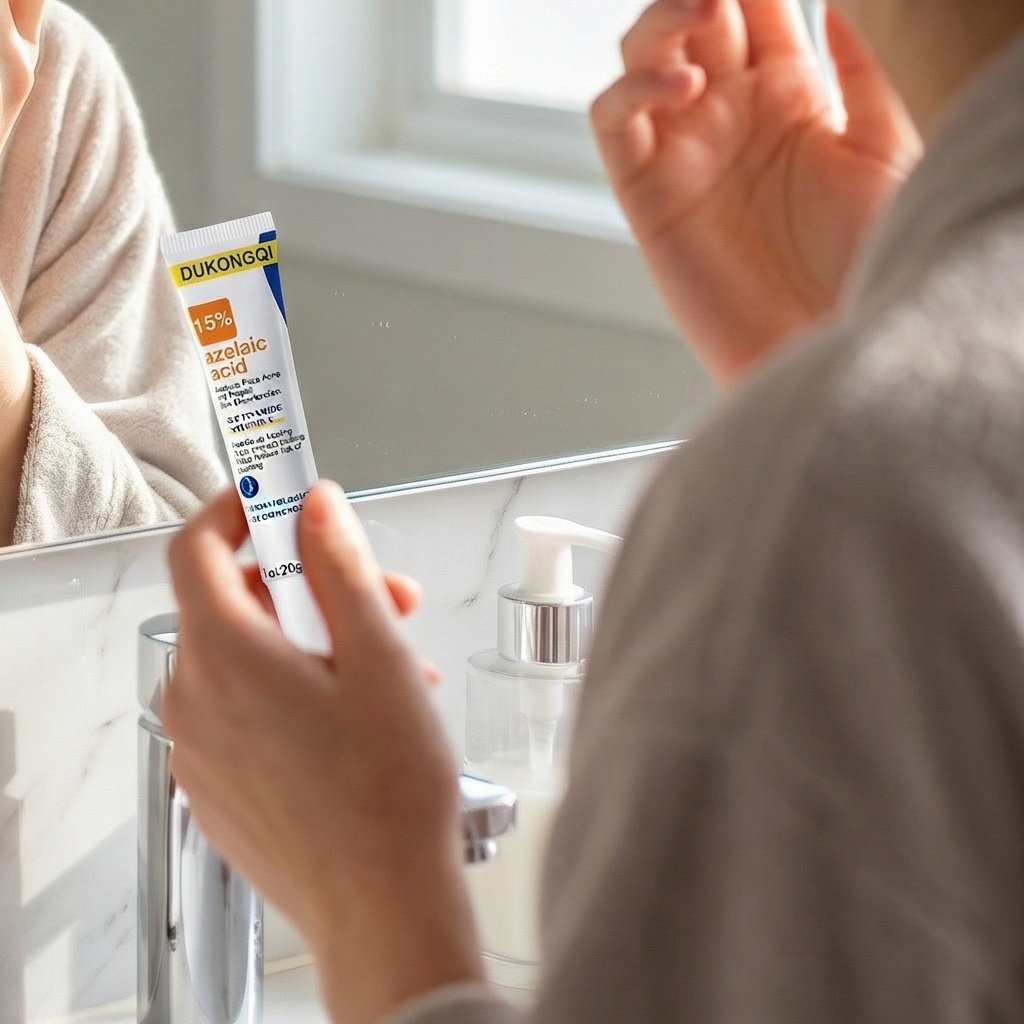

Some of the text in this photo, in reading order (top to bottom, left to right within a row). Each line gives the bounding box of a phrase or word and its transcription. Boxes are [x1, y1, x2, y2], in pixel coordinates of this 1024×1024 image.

[180, 245, 274, 282] DUKONGQI
[193, 310, 233, 334] 15%
[205, 337, 268, 364] azelaic
[211, 357, 248, 381] acid
